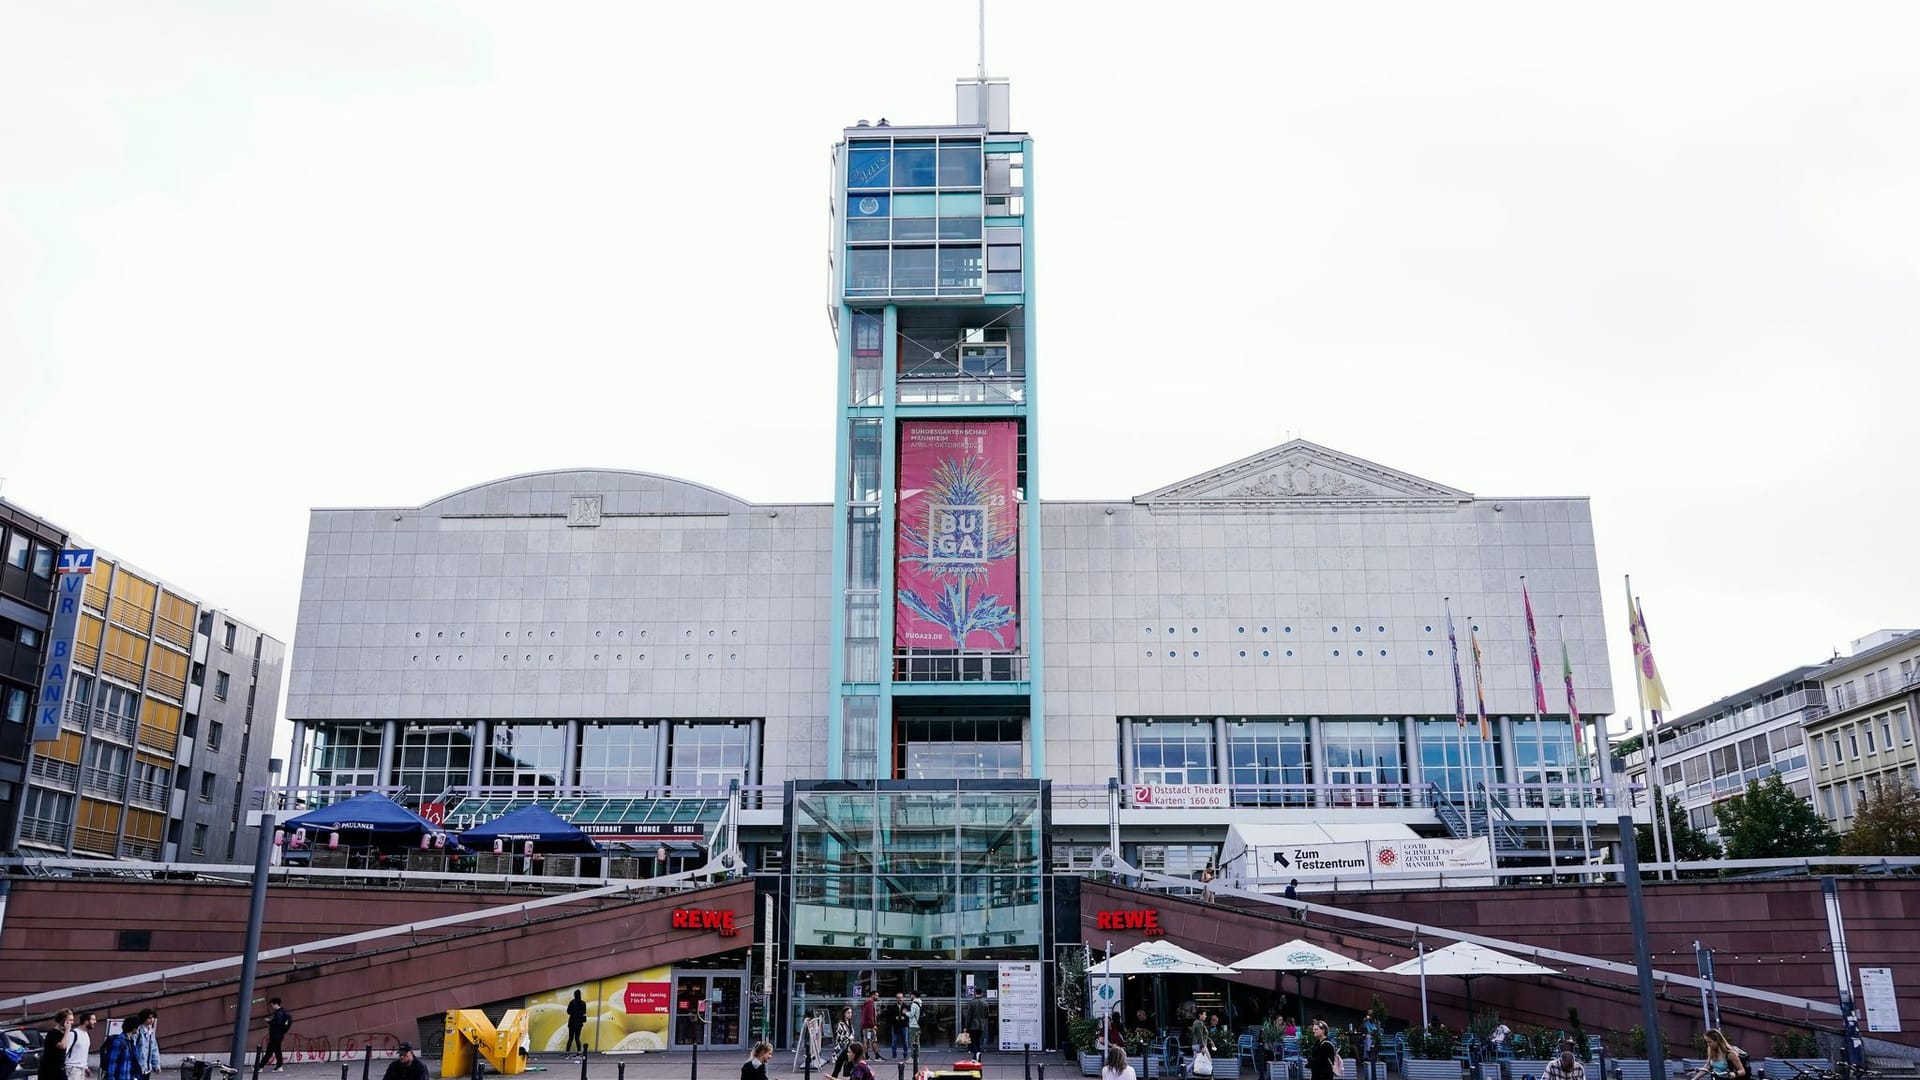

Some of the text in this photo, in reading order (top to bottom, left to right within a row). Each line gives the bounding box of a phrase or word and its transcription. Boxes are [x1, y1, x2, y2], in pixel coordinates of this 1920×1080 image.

[990, 495, 1005, 506] 23
[940, 513, 976, 533] BU
[938, 534, 978, 553] GA
[905, 632, 943, 640] BUGA23.DE
[42, 576, 80, 724] VR BANK
[1154, 786, 1226, 794] Oststadt Theater
[1155, 797, 1220, 805] Karten: 160 60
[341, 822, 375, 830] PAULANER
[580, 825, 694, 833] RESTAURANT LOUNGE SUSHI
[1294, 849, 1319, 859] Zum
[1404, 848, 1454, 856] SCHNELLTEST
[1294, 858, 1365, 870] Testzentrum
[672, 909, 737, 929] REWE
[1097, 909, 1159, 929] REWE
[720, 929, 742, 937] CITY
[1143, 928, 1165, 937] CITY
